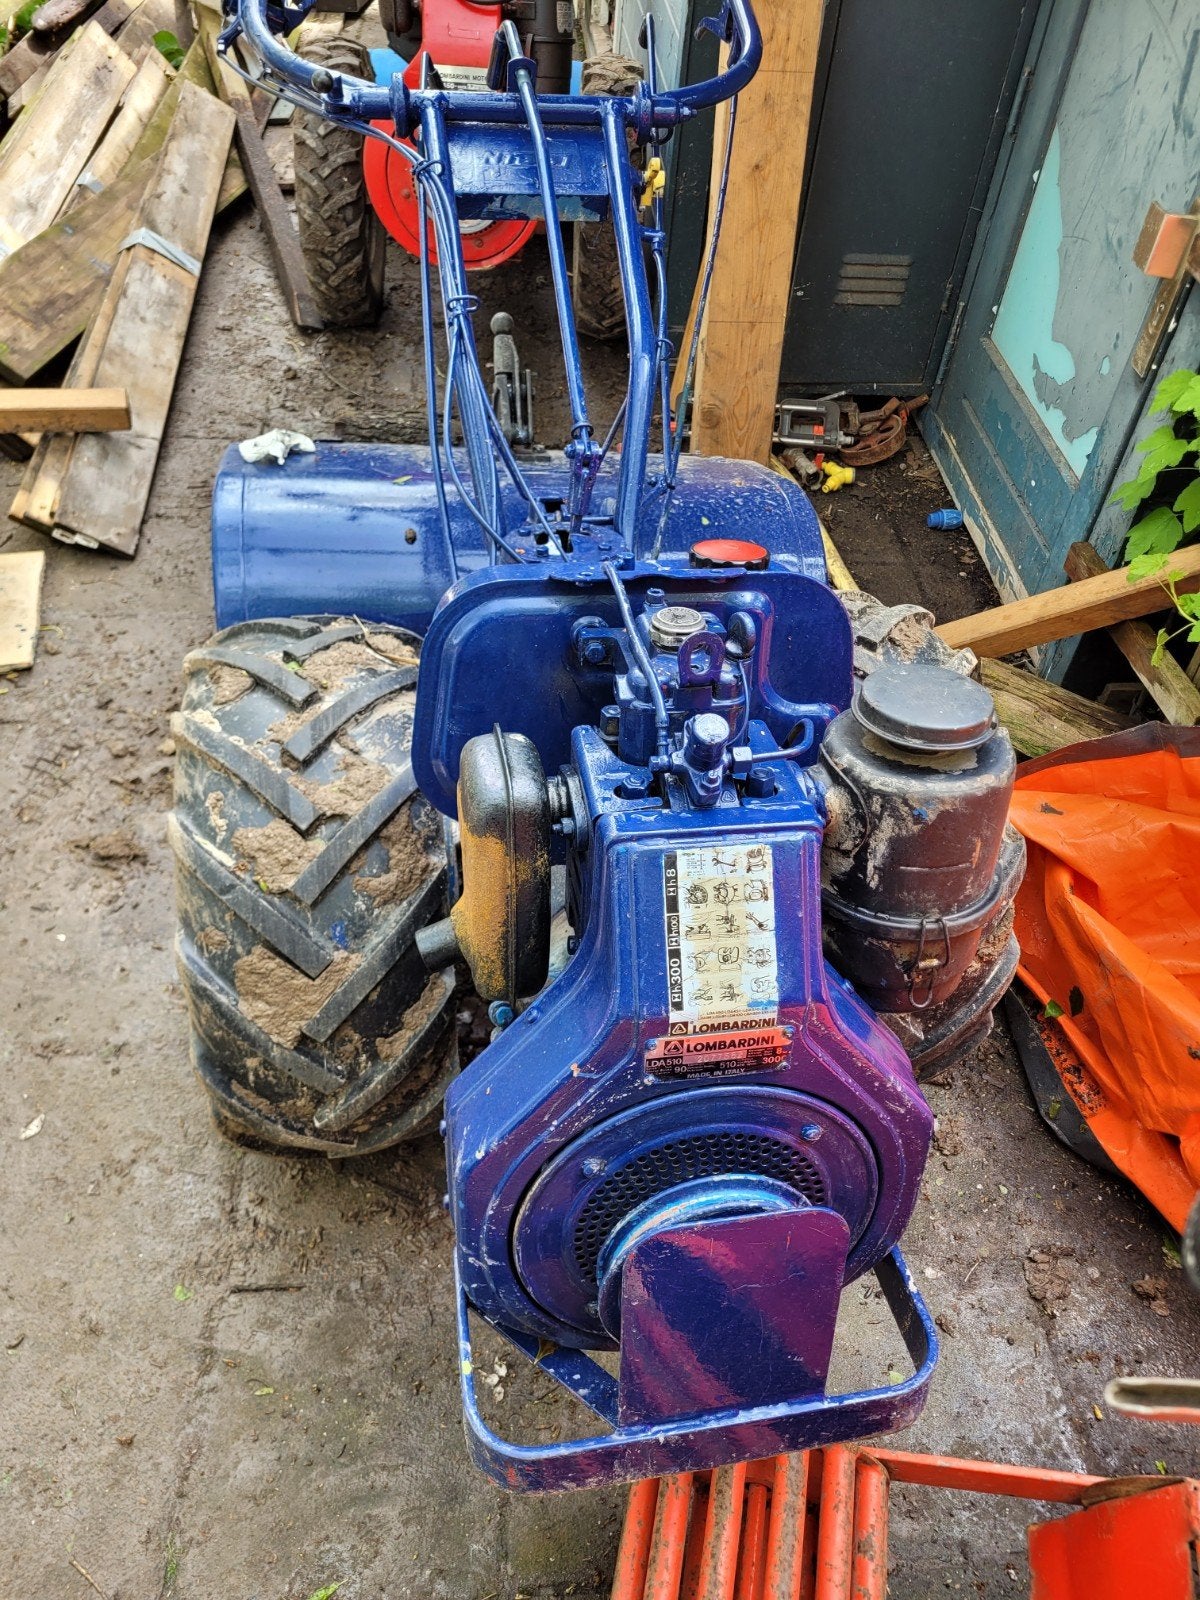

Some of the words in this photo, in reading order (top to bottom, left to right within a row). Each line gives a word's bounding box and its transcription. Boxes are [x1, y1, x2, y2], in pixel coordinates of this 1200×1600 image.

[439, 72, 471, 80] OMBARDINI
[669, 958, 682, 993] h300
[693, 1017, 776, 1034] LOMBARDINI
[686, 1035, 776, 1053] LOMBARDINI
[673, 1065, 687, 1073] 90
[719, 1060, 737, 1069] 510
